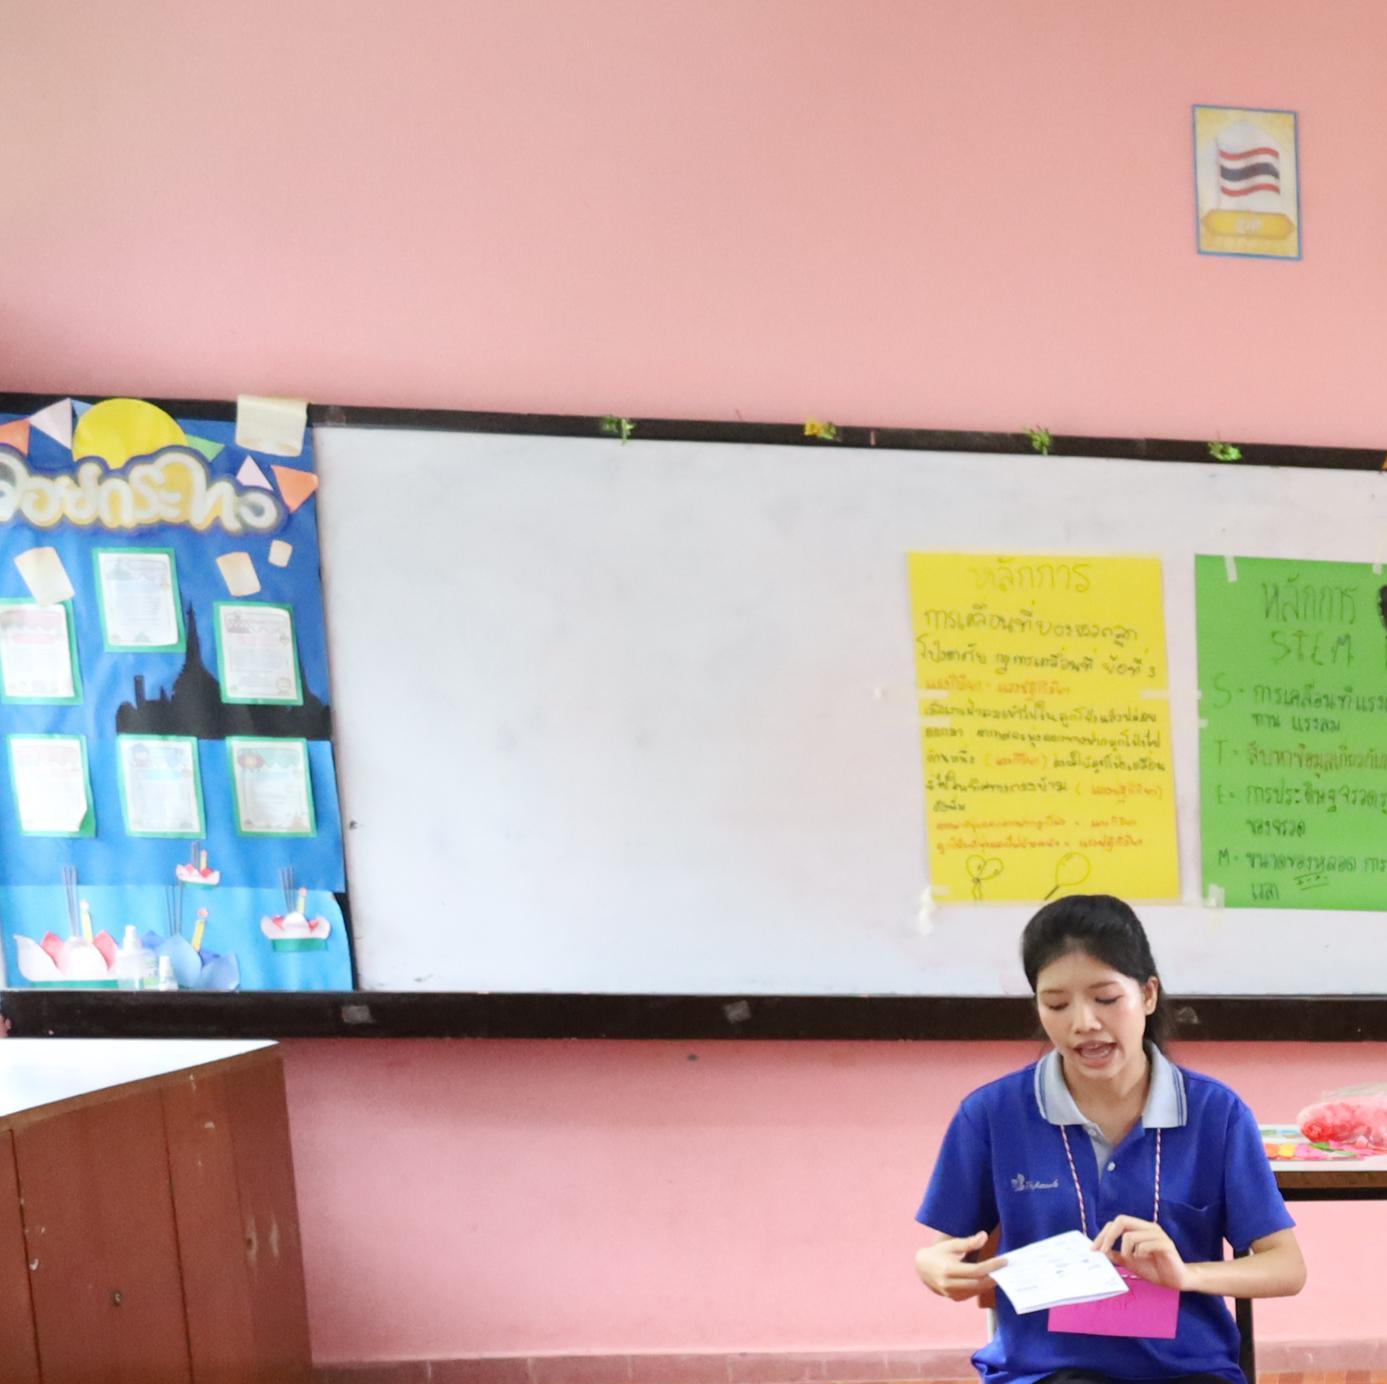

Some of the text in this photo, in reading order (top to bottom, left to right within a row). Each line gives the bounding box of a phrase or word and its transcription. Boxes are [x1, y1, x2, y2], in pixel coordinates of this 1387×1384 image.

[1262, 573, 1359, 625] หลักการ
[1271, 630, 1354, 666] STEM
